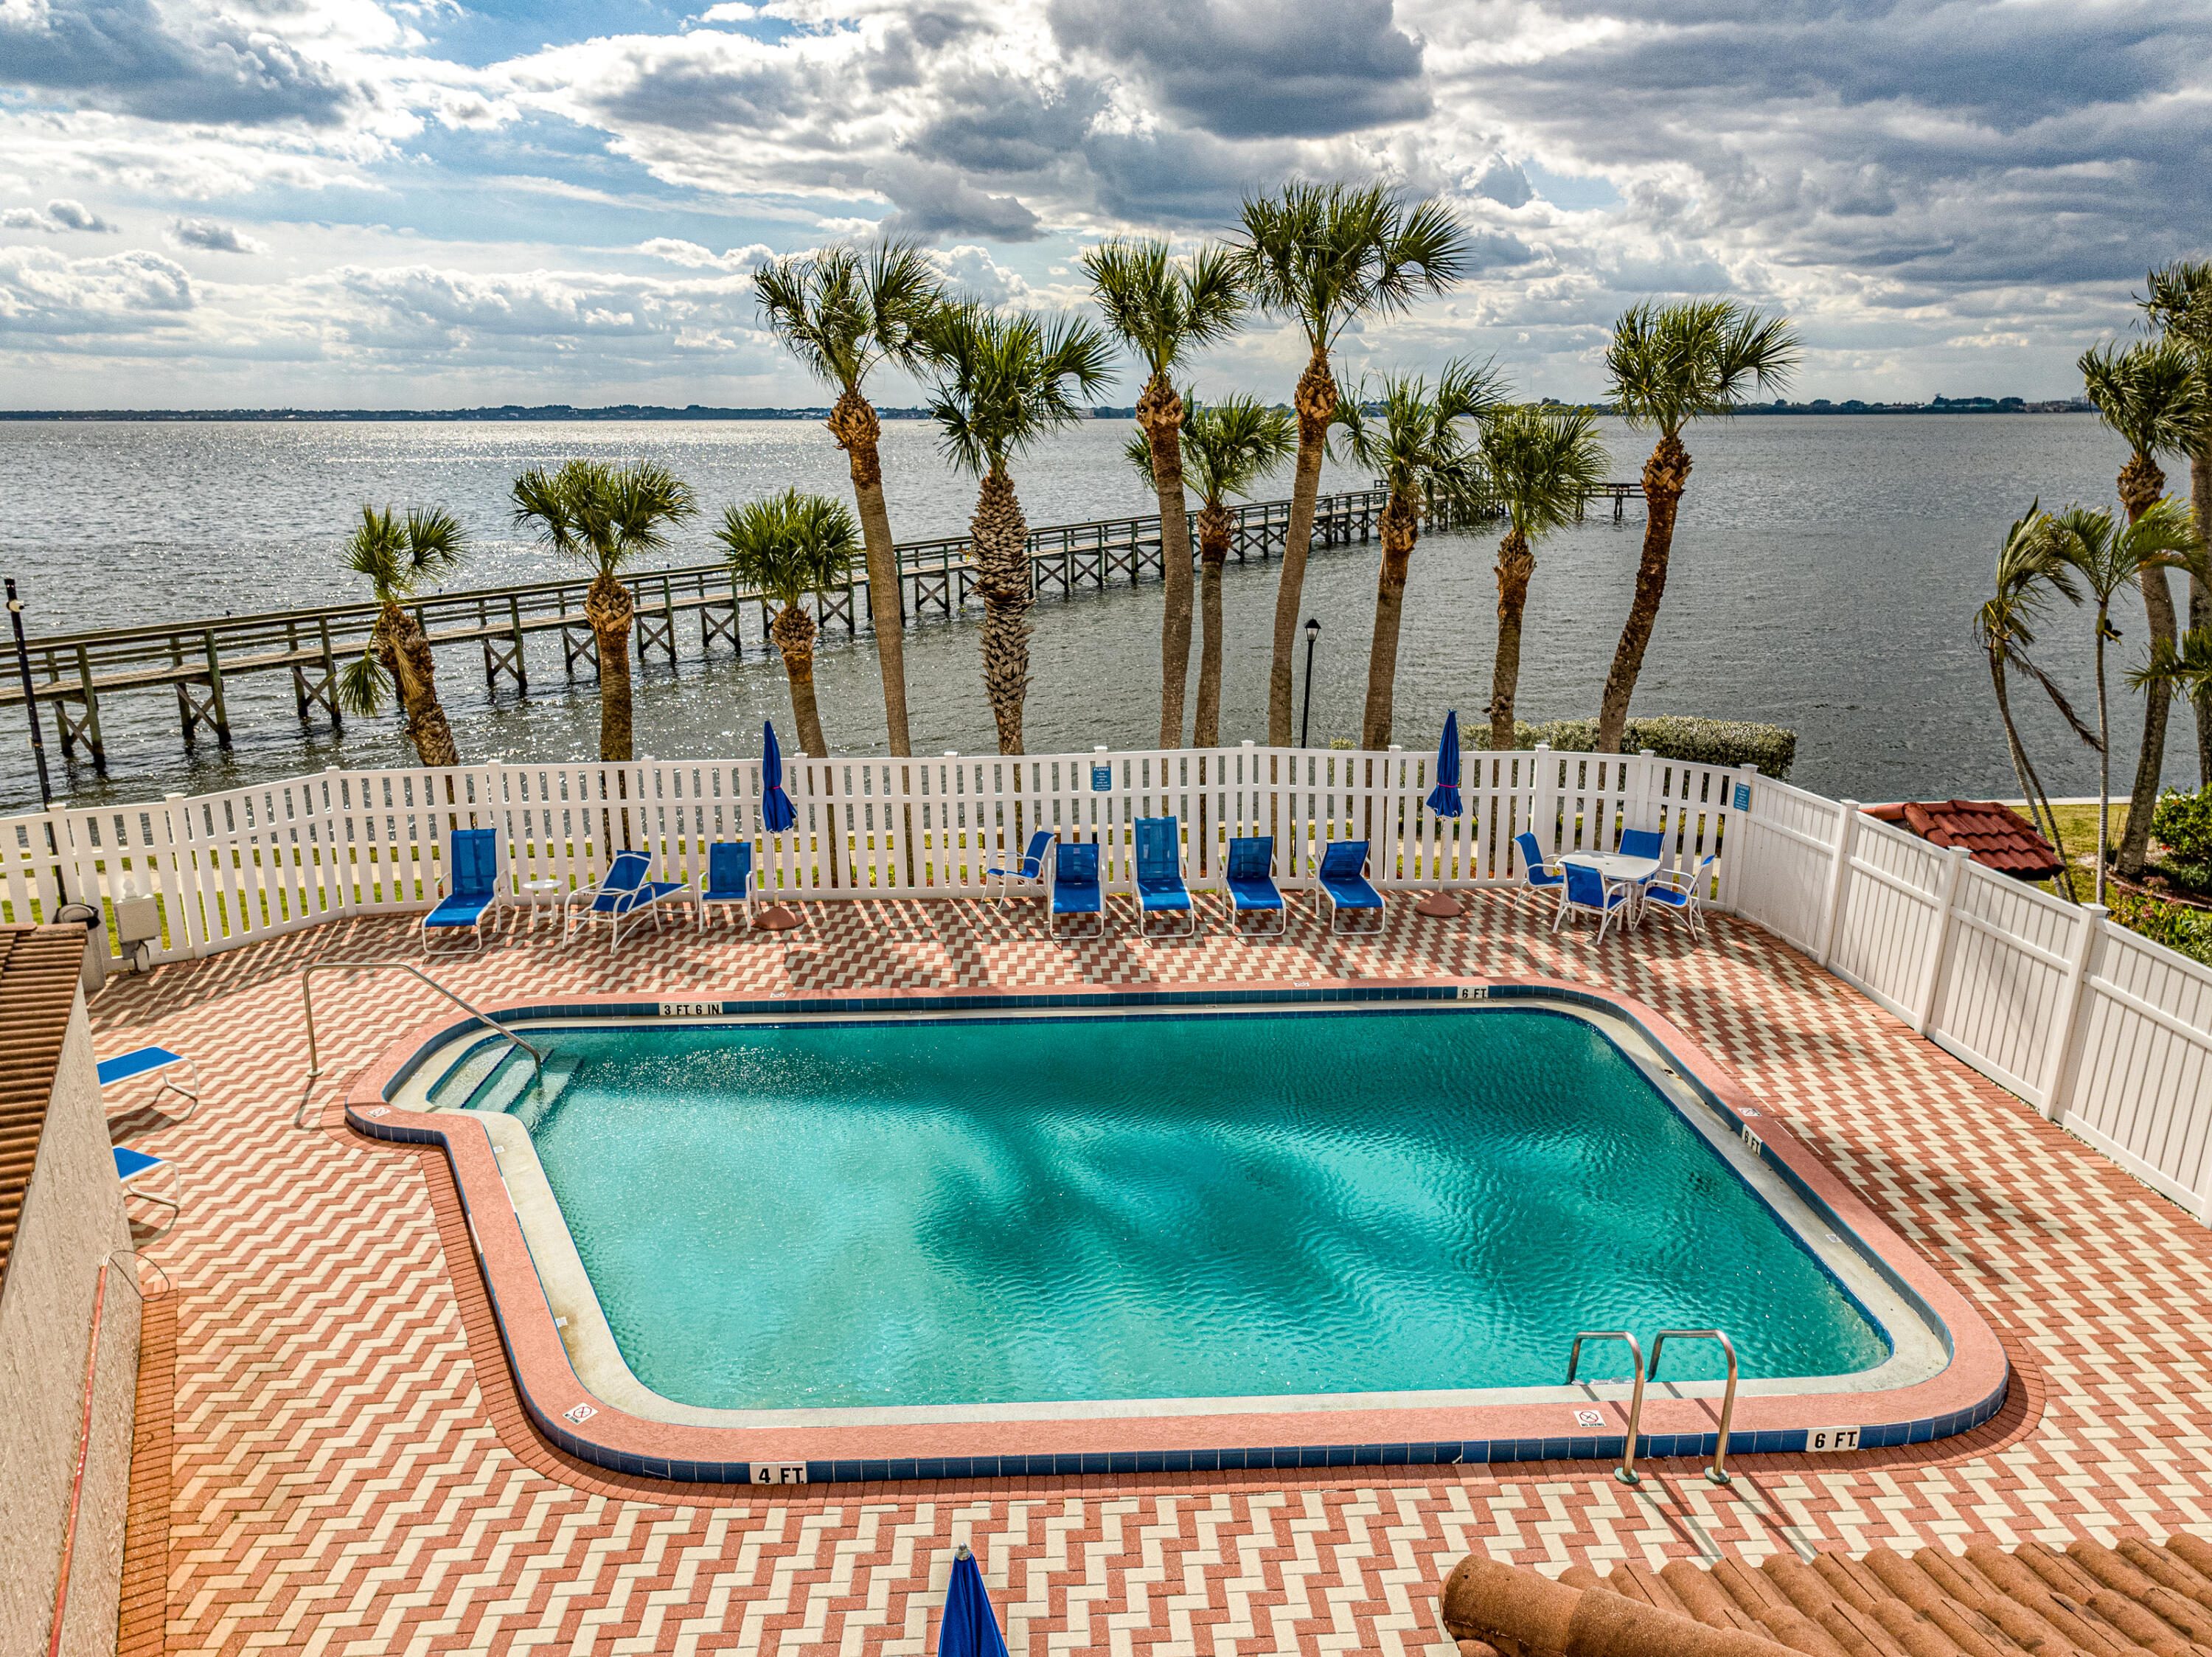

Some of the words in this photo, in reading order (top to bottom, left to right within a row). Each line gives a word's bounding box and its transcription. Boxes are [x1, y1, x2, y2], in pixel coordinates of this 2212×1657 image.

[1462, 989, 1469, 998] 6
[664, 1005, 671, 1015] 3
[695, 1004, 703, 1015] 6
[708, 1004, 722, 1015] IN.
[1745, 1130, 1749, 1143] 6
[1815, 1433, 1826, 1449] 6
[1834, 1431, 1857, 1448] FT.
[759, 1468, 771, 1484] 4
[780, 1467, 804, 1484] FT.
